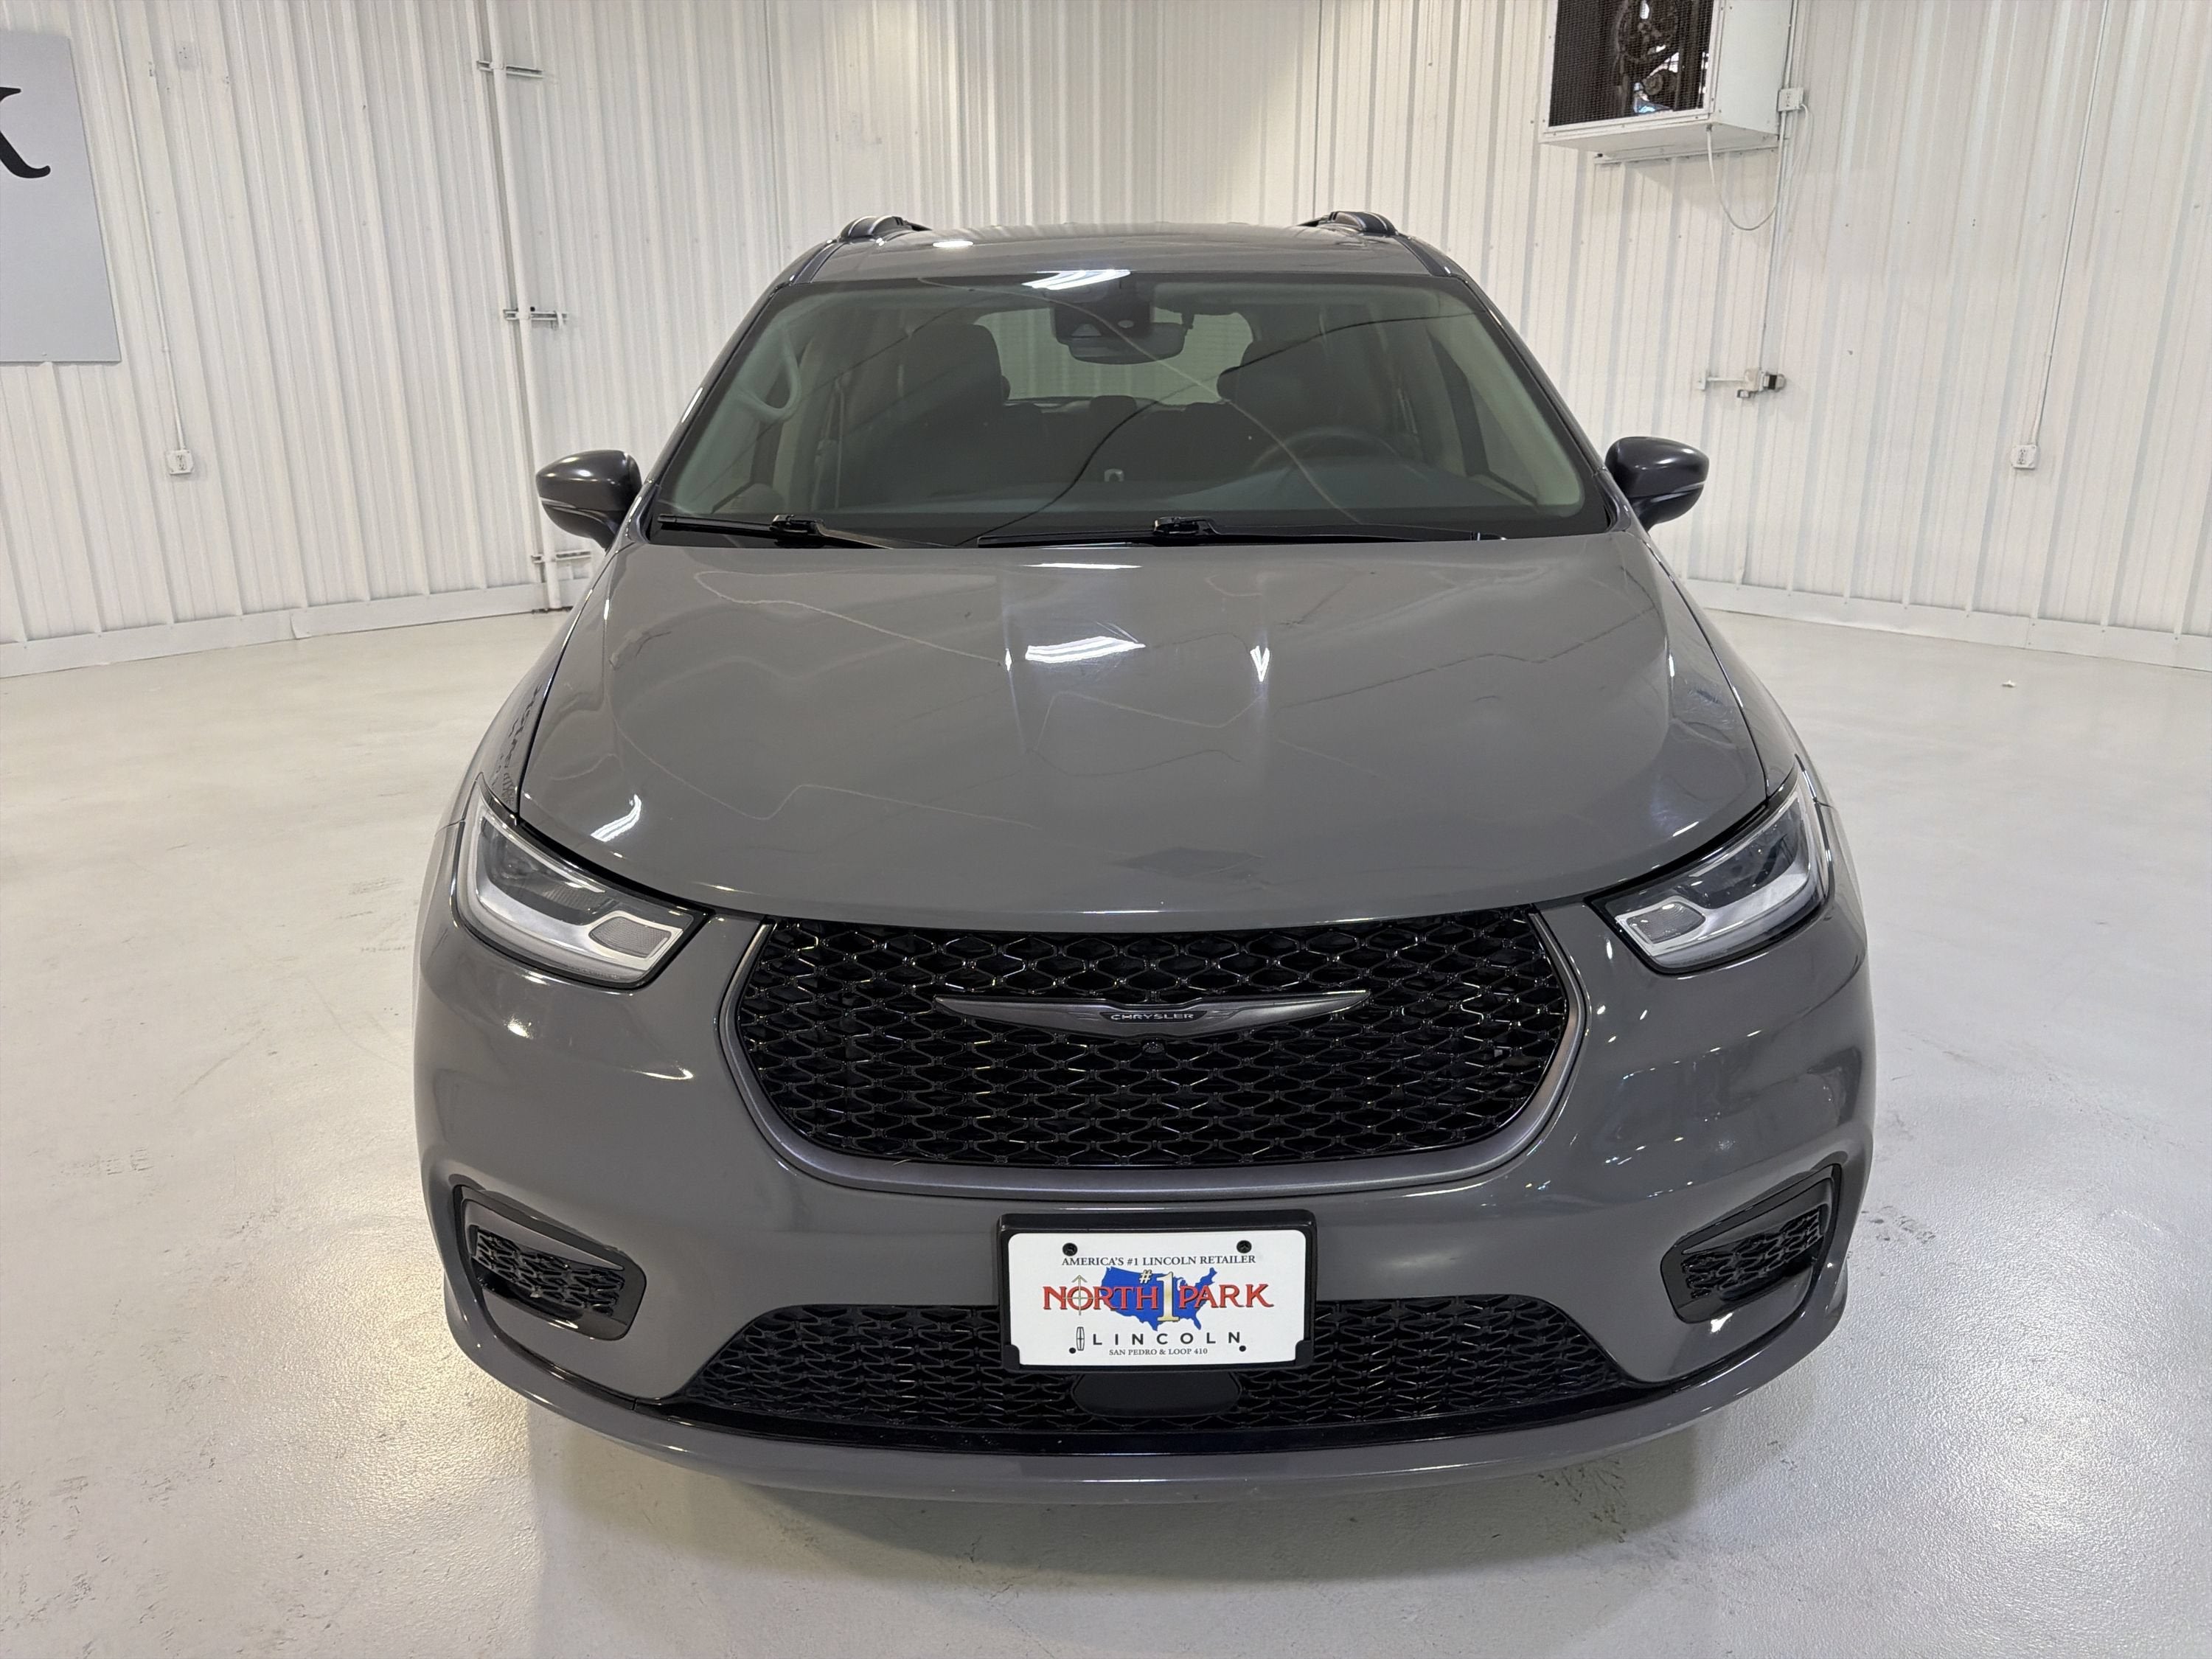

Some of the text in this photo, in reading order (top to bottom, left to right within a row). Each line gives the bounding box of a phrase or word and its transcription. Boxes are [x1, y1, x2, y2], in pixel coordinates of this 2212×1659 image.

[1062, 1255, 1256, 1266] AMERICA'S #1 LINCOLN RETAILER
[1043, 1286, 1159, 1310] NORTH
[1178, 1284, 1274, 1309] PARK
[1093, 1332, 1240, 1345] LINCOLN
